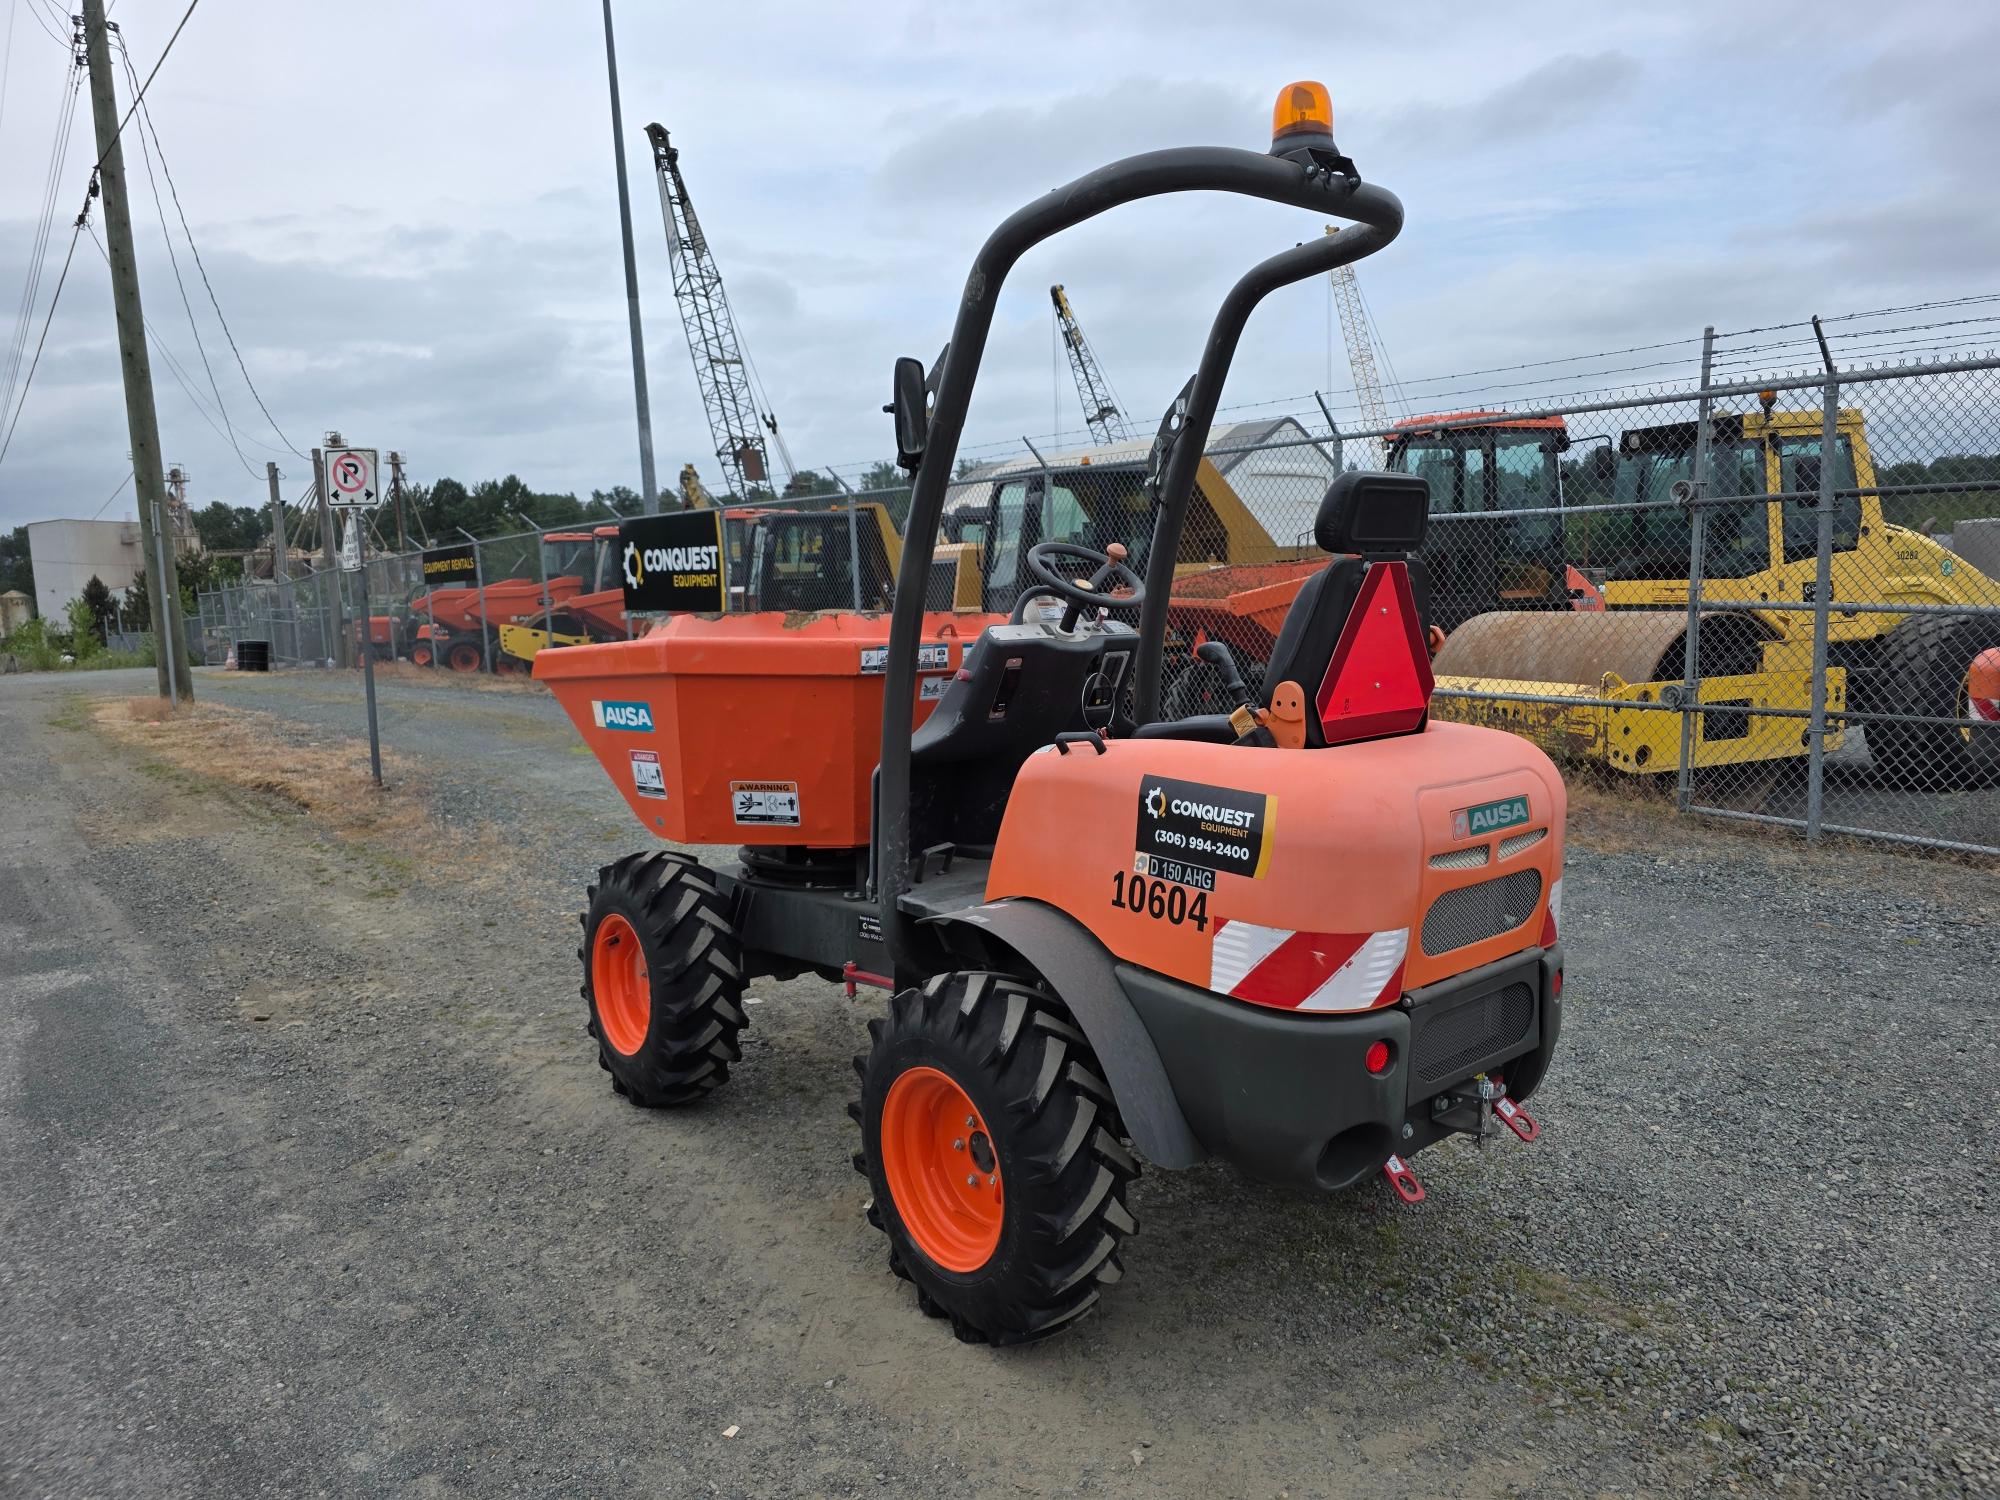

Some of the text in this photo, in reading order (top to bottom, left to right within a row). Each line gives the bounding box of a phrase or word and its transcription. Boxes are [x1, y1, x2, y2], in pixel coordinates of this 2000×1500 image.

[424, 557, 475, 574] EQUIPMENT RENTALS
[643, 546, 718, 572] CONQUEST
[673, 574, 718, 588] EQUIPMENT
[605, 706, 653, 727] AUSA
[745, 784, 790, 792] WARNING
[1171, 799, 1255, 828] CONQUEST
[1471, 802, 1528, 831] AUSA
[1200, 821, 1249, 839] EQUIPMENT
[1155, 829, 1250, 860] (306) 994-2400
[1150, 858, 1212, 889] D 150 AHG
[1112, 870, 1209, 933] 10604
